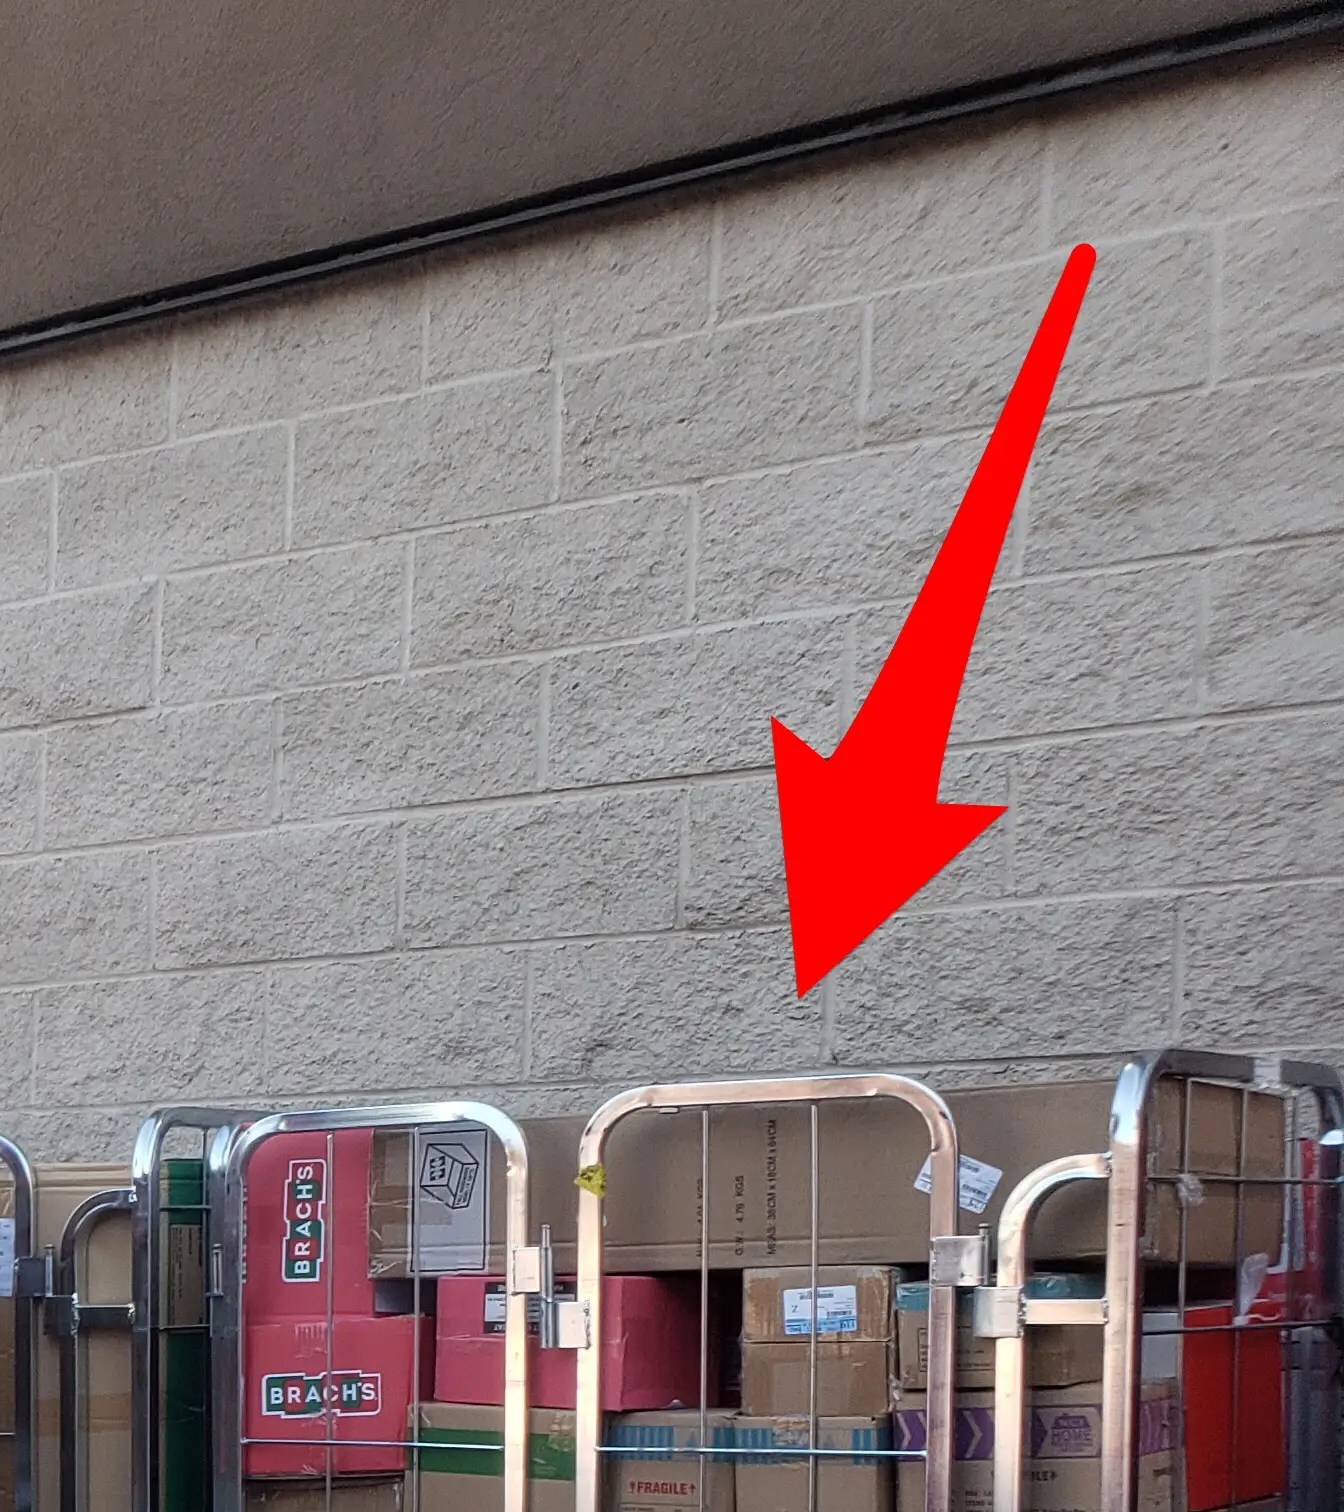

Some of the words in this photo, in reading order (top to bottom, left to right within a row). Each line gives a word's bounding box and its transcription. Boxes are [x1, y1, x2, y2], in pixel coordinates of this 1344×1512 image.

[294, 1164, 314, 1275] BRACH'S
[269, 1381, 377, 1405] BRACH'S
[637, 1481, 688, 1496] FRAGILE
